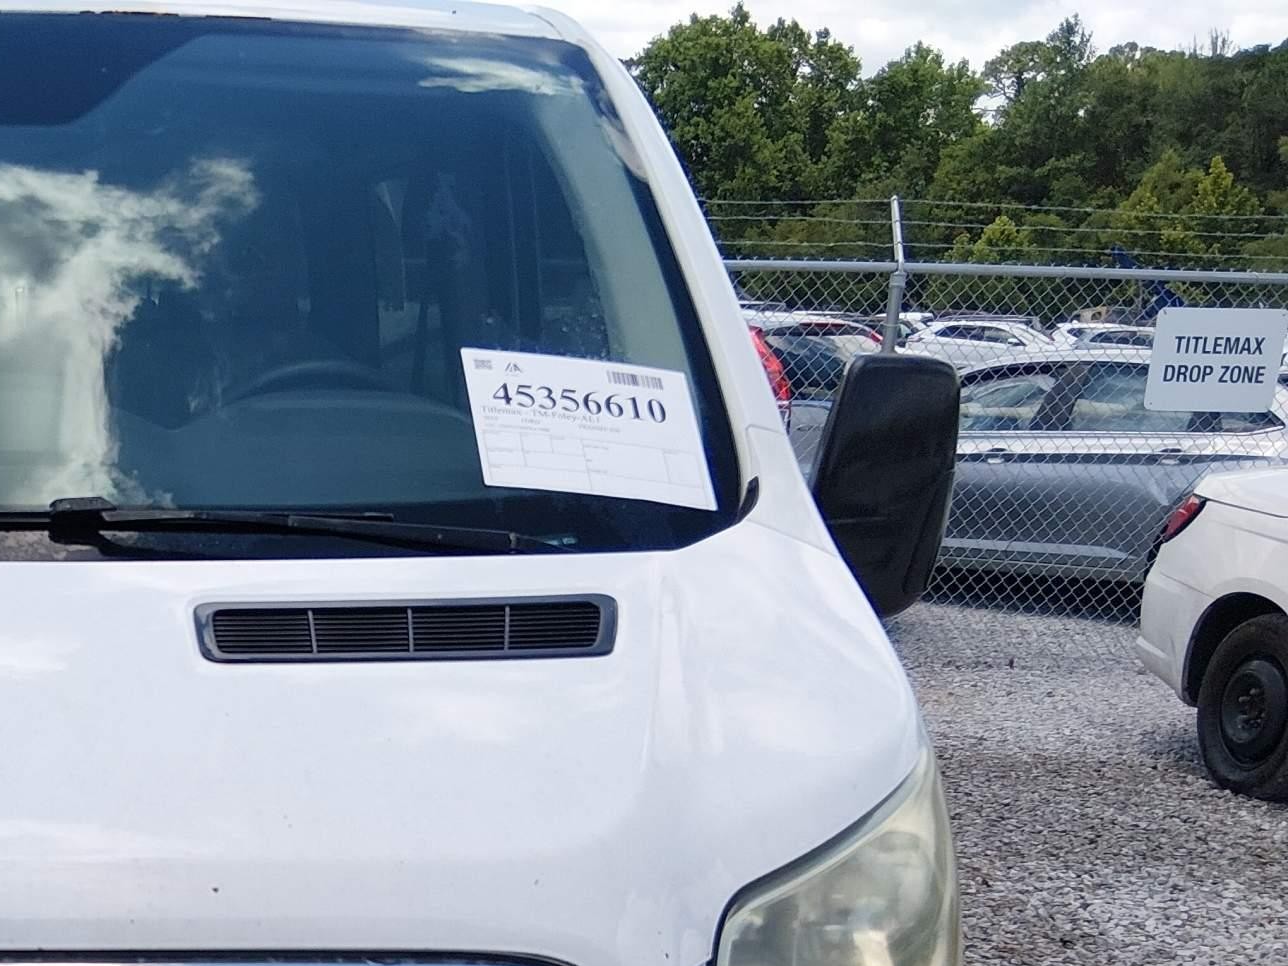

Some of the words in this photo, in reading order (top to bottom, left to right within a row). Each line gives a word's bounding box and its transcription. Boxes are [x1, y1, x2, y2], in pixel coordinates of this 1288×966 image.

[1175, 336, 1266, 355] TITLEMAX
[1163, 365, 1214, 383] DROP
[1218, 366, 1266, 384] ZONE
[492, 382, 667, 423] 45356610
